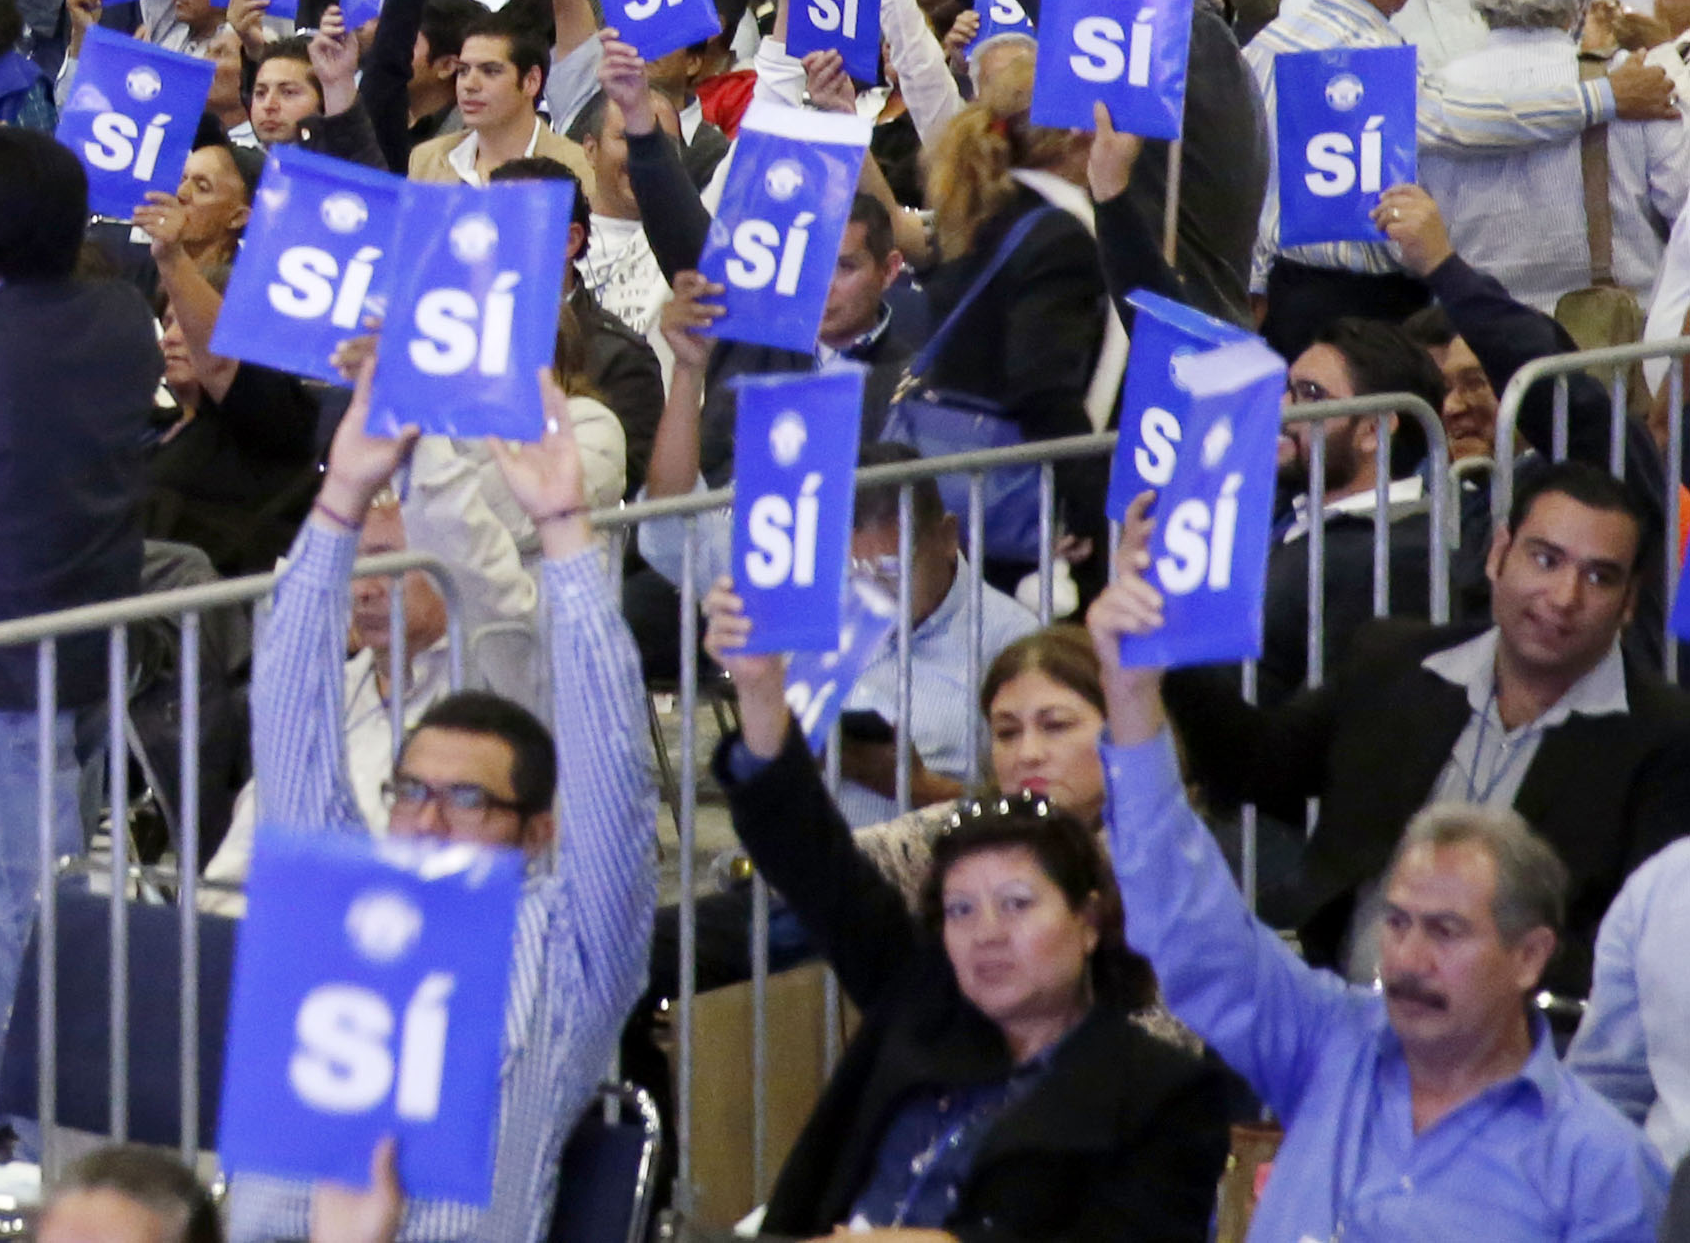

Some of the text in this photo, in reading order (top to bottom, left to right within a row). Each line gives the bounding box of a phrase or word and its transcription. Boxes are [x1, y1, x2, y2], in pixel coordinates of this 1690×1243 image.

[73, 103, 171, 181] SÍ
[1305, 116, 1384, 196] SÍ
[269, 246, 385, 328] SÍ
[726, 212, 815, 295] SÍ
[409, 272, 519, 376] SÍ
[746, 473, 822, 587] SÍ
[1157, 473, 1242, 593] SÍ
[290, 974, 452, 1120] SÍ
